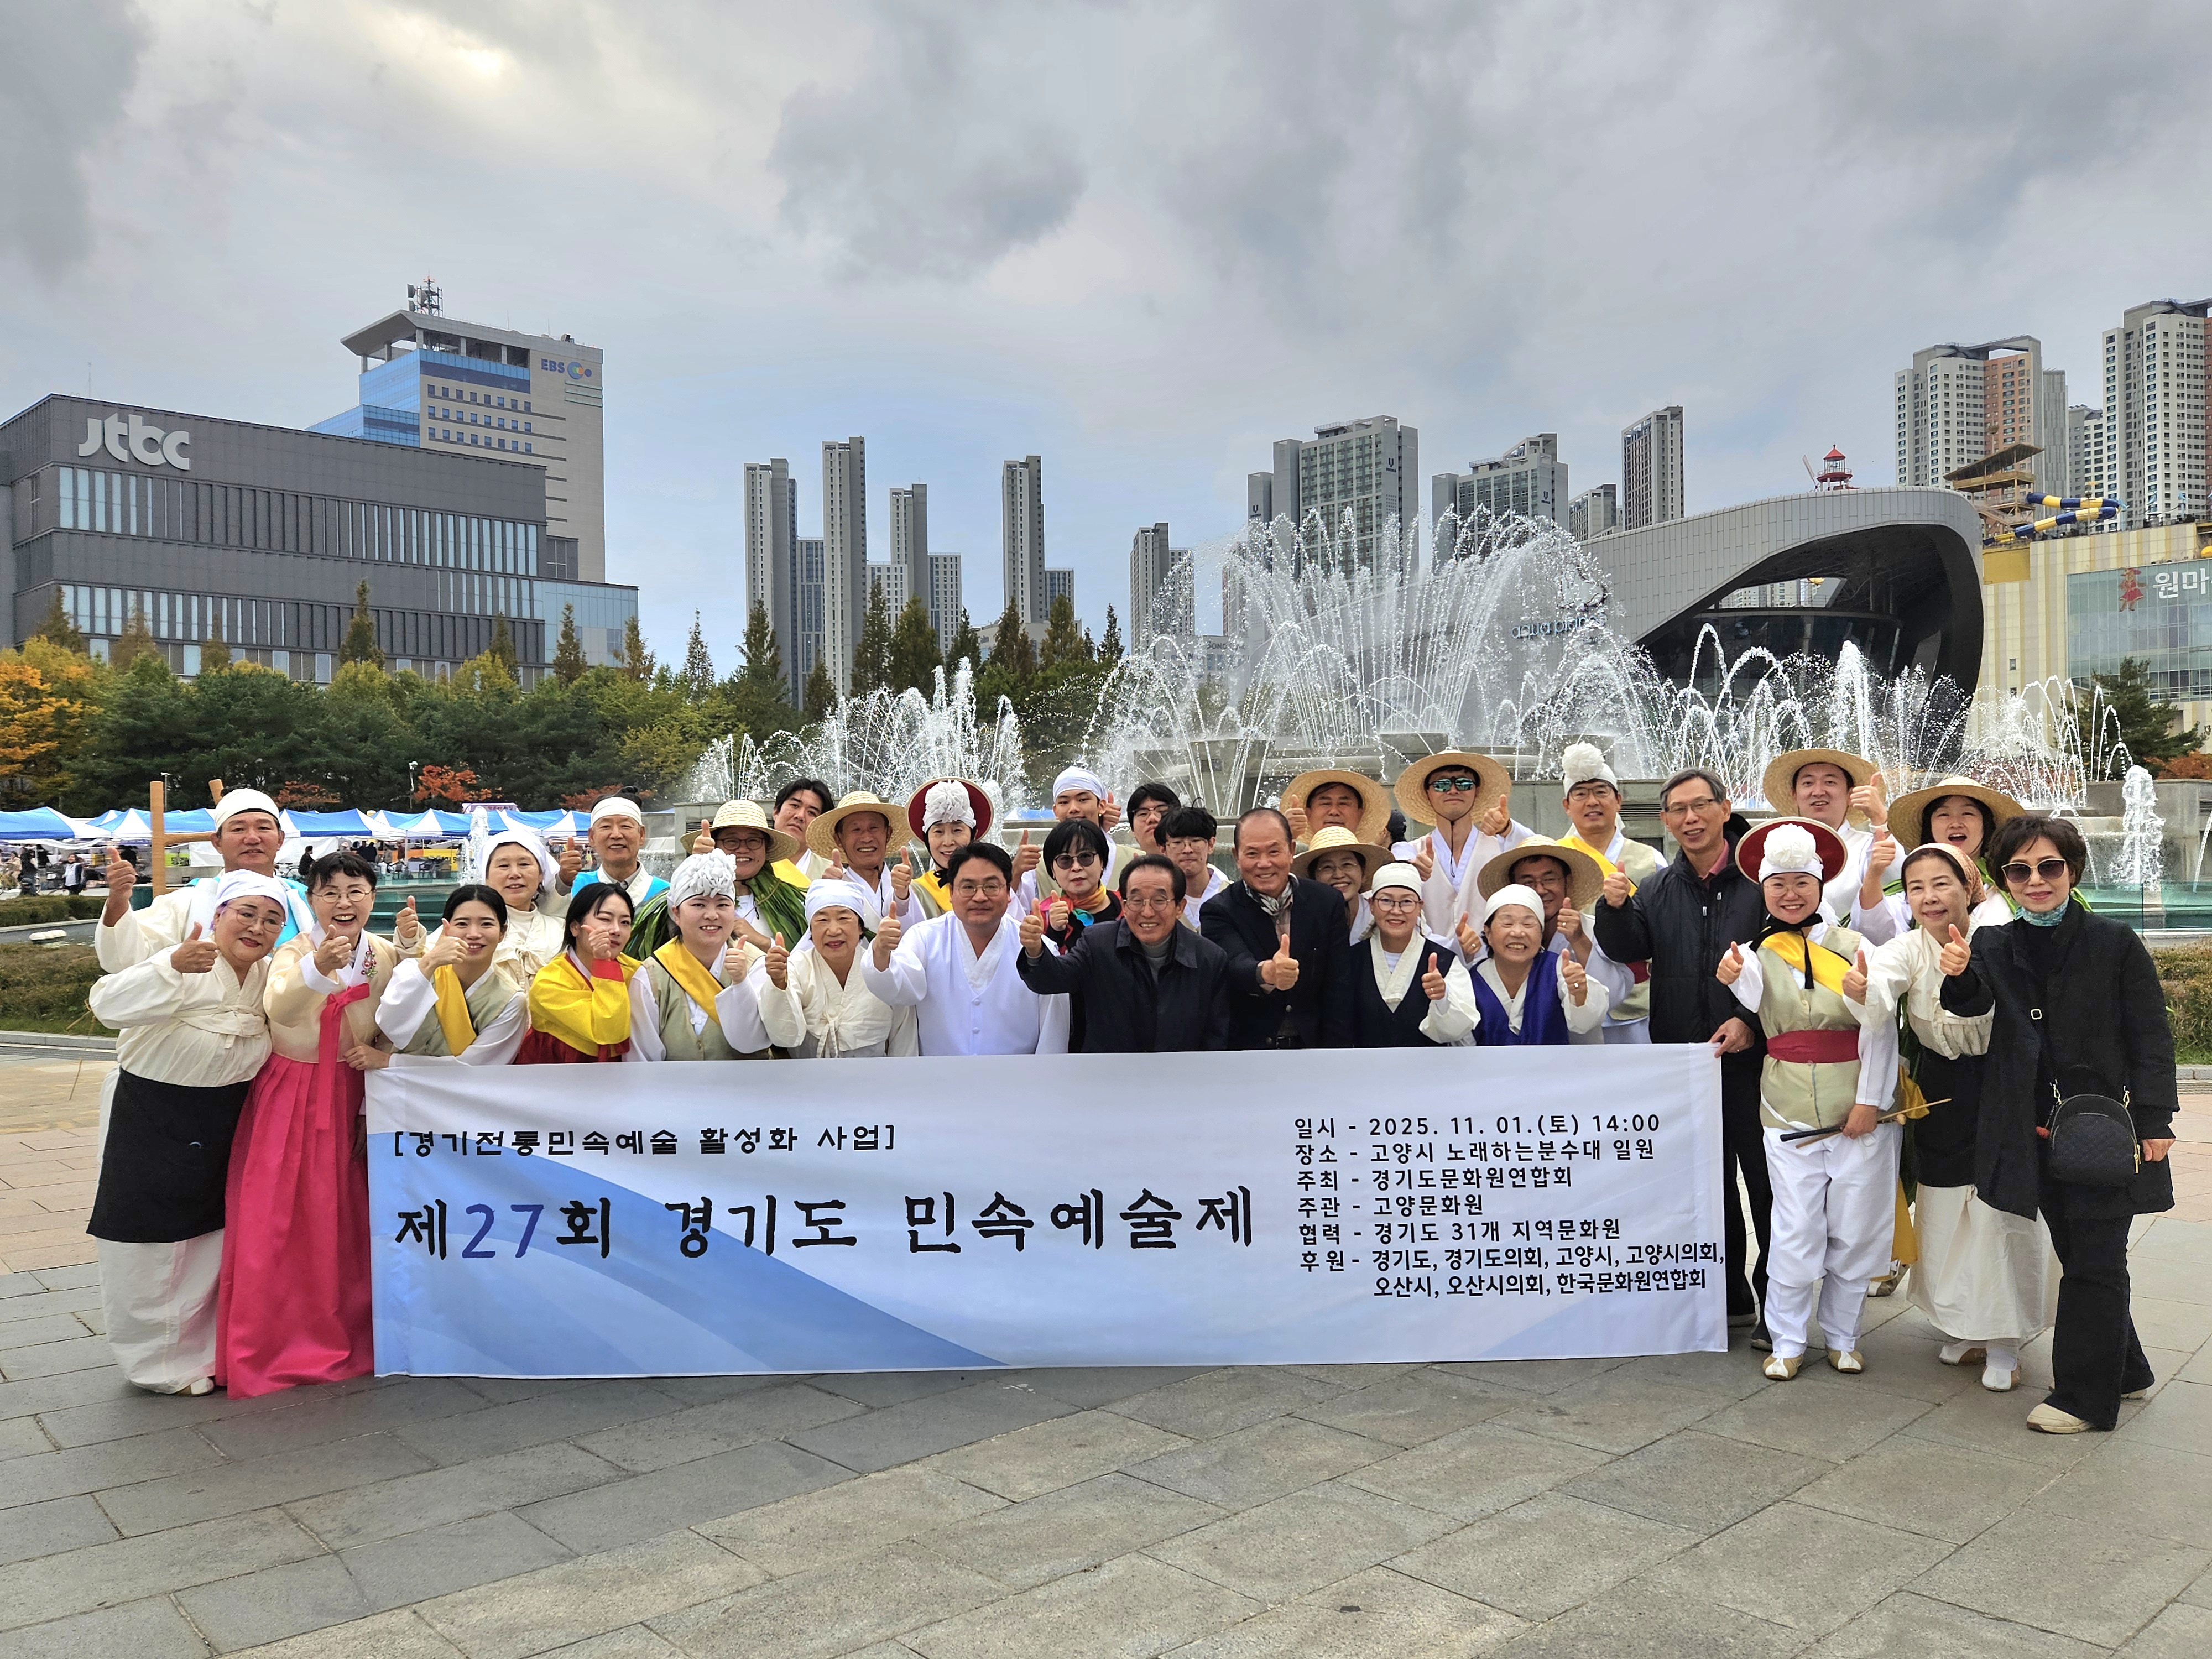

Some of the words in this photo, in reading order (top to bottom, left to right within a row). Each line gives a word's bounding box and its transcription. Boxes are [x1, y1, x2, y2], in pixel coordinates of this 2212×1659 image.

[541, 358, 565, 373] EBS
[2153, 568, 2212, 599] 원마
[394, 1129, 678, 1157] [경기전통민속예술
[699, 1127, 798, 1155] 활성화
[817, 1124, 894, 1151] 사업]
[1295, 1118, 1335, 1139] 일시
[1369, 1118, 1438, 1135] 2025.
[1451, 1117, 1484, 1134] 11.
[1496, 1114, 1579, 1136] 01.(토)
[1592, 1114, 1660, 1132] 14:00
[1295, 1144, 1338, 1166] 장소
[1370, 1142, 1433, 1164] 고양시
[1447, 1140, 1600, 1162] 노래하는분수대
[1613, 1139, 1654, 1160] 일원
[1297, 1170, 1338, 1192] 주최
[1372, 1166, 1572, 1191] 경기도문화원연합회
[1298, 1197, 1340, 1218] 주관
[1373, 1194, 1483, 1218] 고양문화원
[394, 1197, 611, 1261] 제27회
[664, 1194, 857, 1258] 경기도
[904, 1185, 1252, 1254] 민속예술제
[1298, 1223, 1340, 1246] 협력
[1374, 1222, 1439, 1245] 경기도
[1452, 1220, 1500, 1243] 31개
[1512, 1218, 1620, 1241] 지역문화원
[1300, 1250, 1344, 1272] 후원
[1372, 1249, 1437, 1272] 경기도,
[1444, 1246, 1549, 1270] 경기도의회,
[1556, 1245, 1619, 1268] 고양시,
[1626, 1242, 1724, 1265] 고양시의회,
[1374, 1276, 1439, 1299] 오산시,
[1446, 1274, 1551, 1296] 오산시의회,
[1556, 1269, 1706, 1295] 한국문화원연합회
